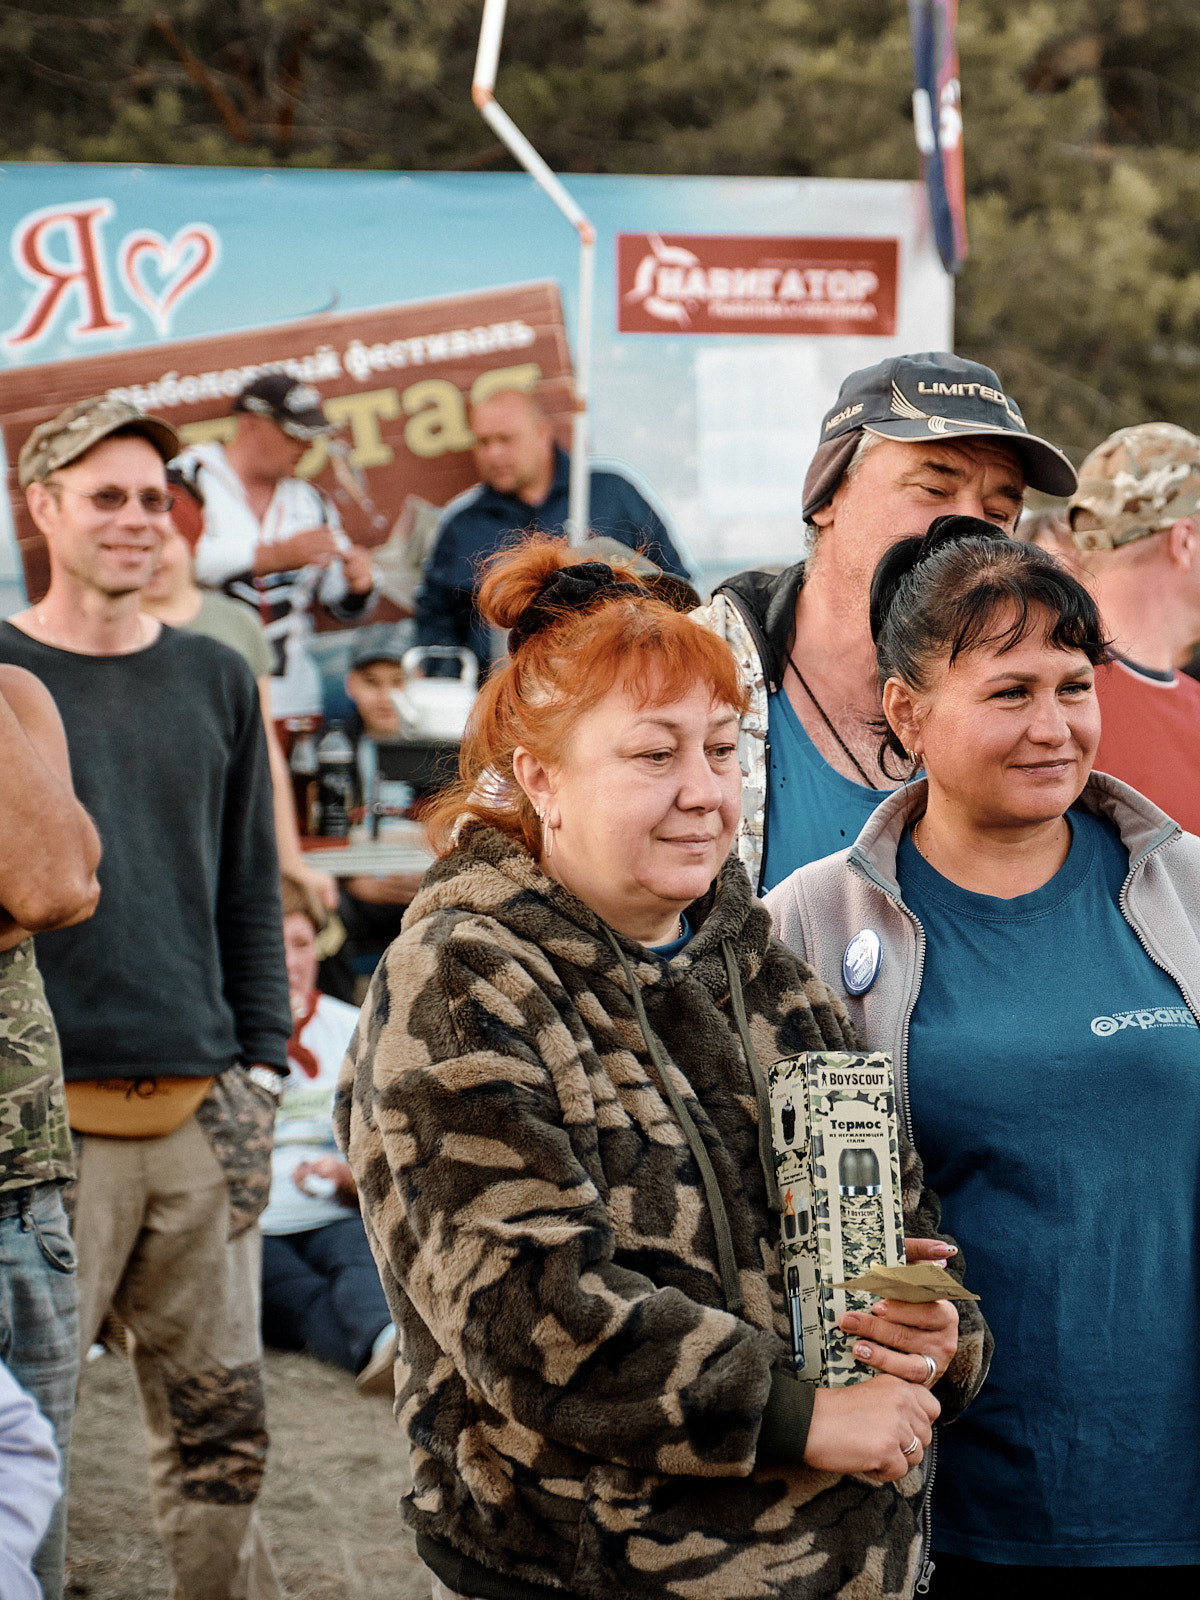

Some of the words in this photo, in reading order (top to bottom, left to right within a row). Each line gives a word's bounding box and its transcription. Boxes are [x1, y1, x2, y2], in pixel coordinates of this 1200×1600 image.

[6, 203, 127, 346] Я
[656, 266, 880, 302] НАВИГАТОР
[917, 380, 1006, 406] LIMITED
[824, 402, 865, 433] NEXUS
[830, 1119, 882, 1132] Термос
